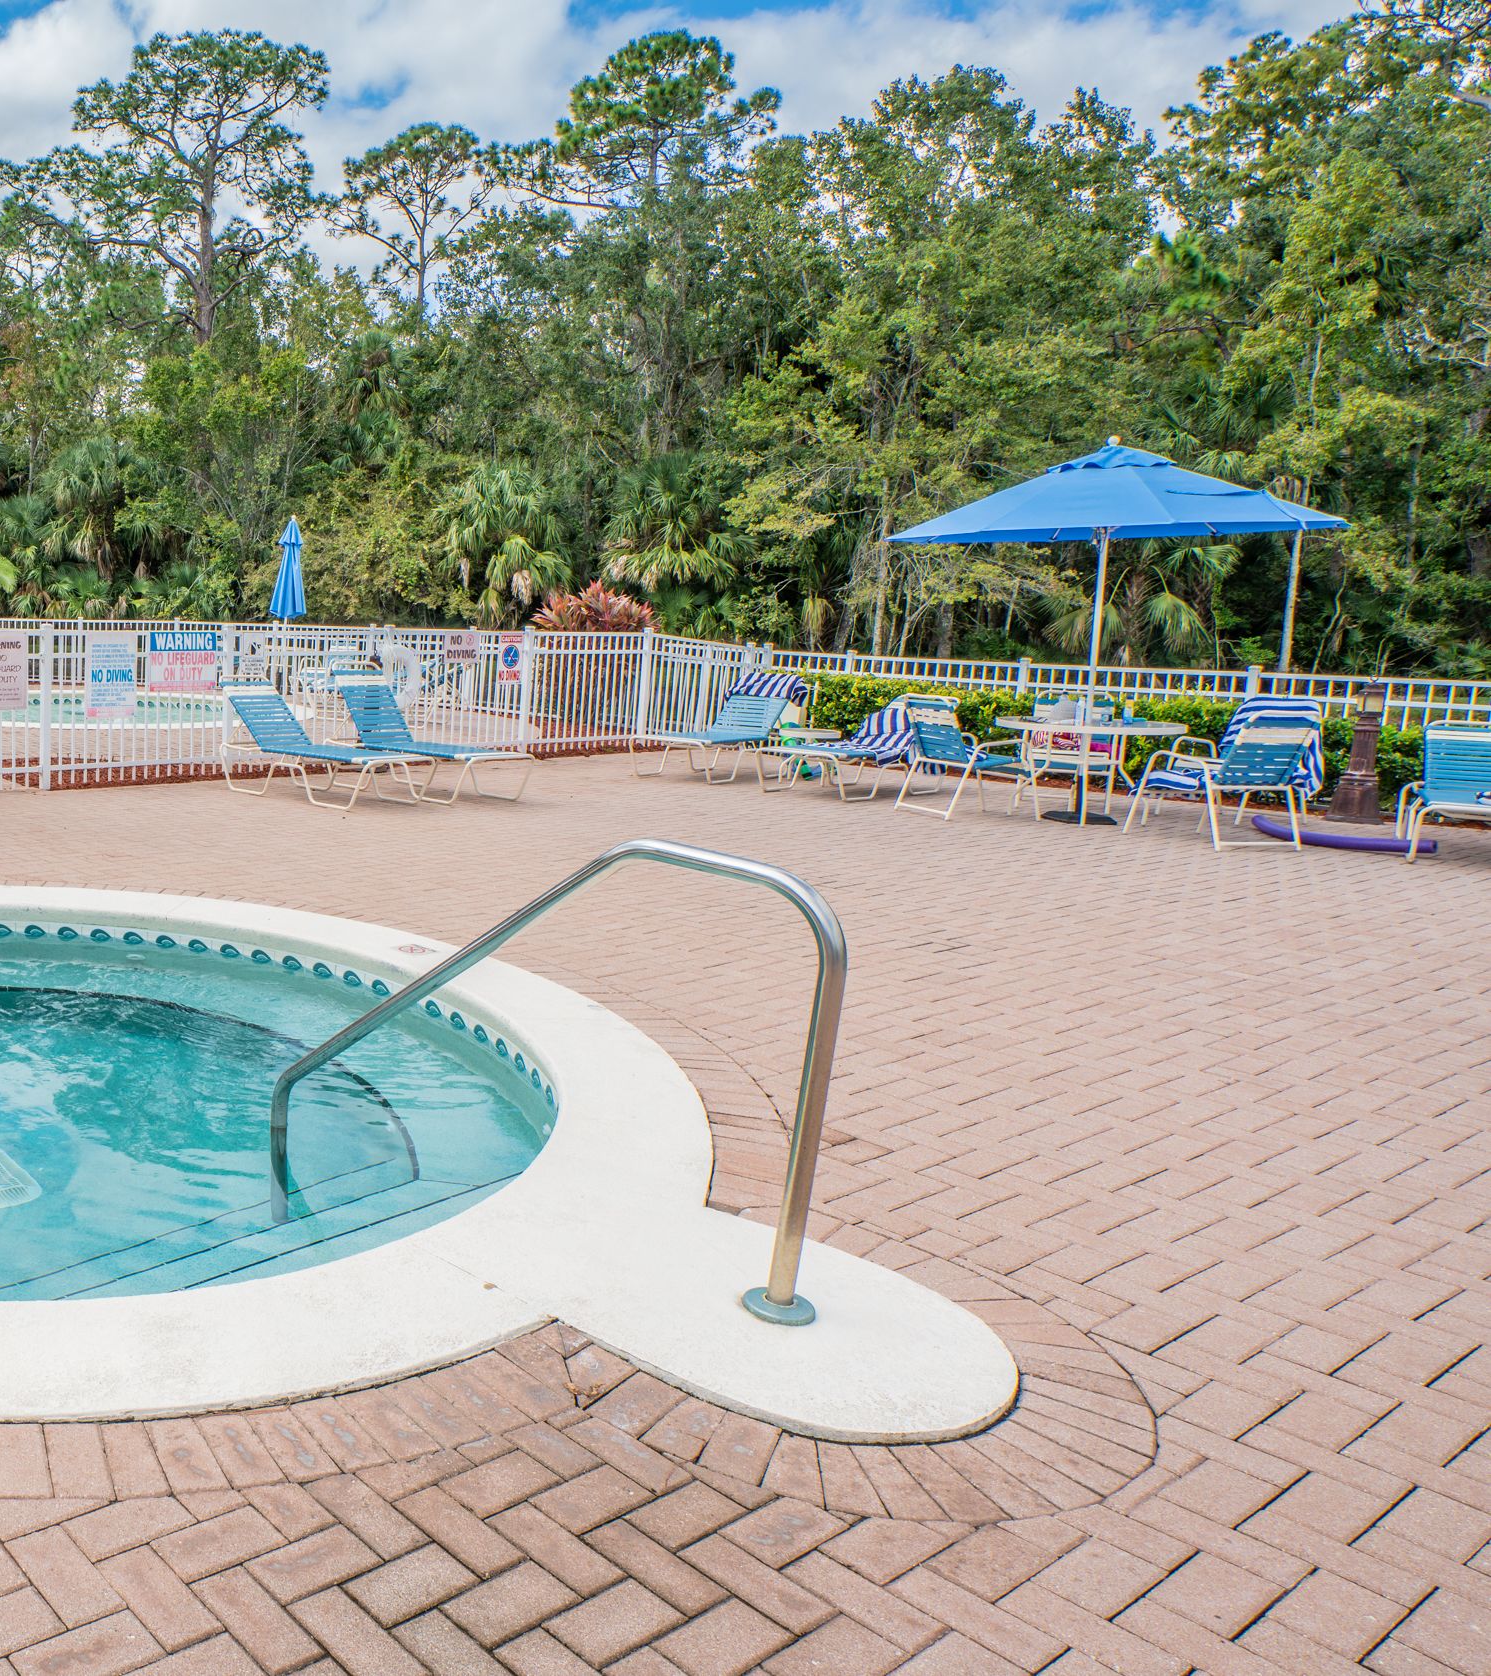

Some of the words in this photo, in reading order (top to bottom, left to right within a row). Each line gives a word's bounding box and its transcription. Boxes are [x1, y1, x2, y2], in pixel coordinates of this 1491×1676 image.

[155, 633, 213, 650] WARNING
[451, 635, 463, 645] NO
[151, 652, 164, 666] NO
[167, 651, 216, 666] LIFEGUARD
[446, 649, 477, 659] DIVING
[91, 669, 104, 683] NO
[106, 668, 135, 683] DIVING.
[163, 667, 176, 681] ON
[180, 667, 203, 681] DUTY
